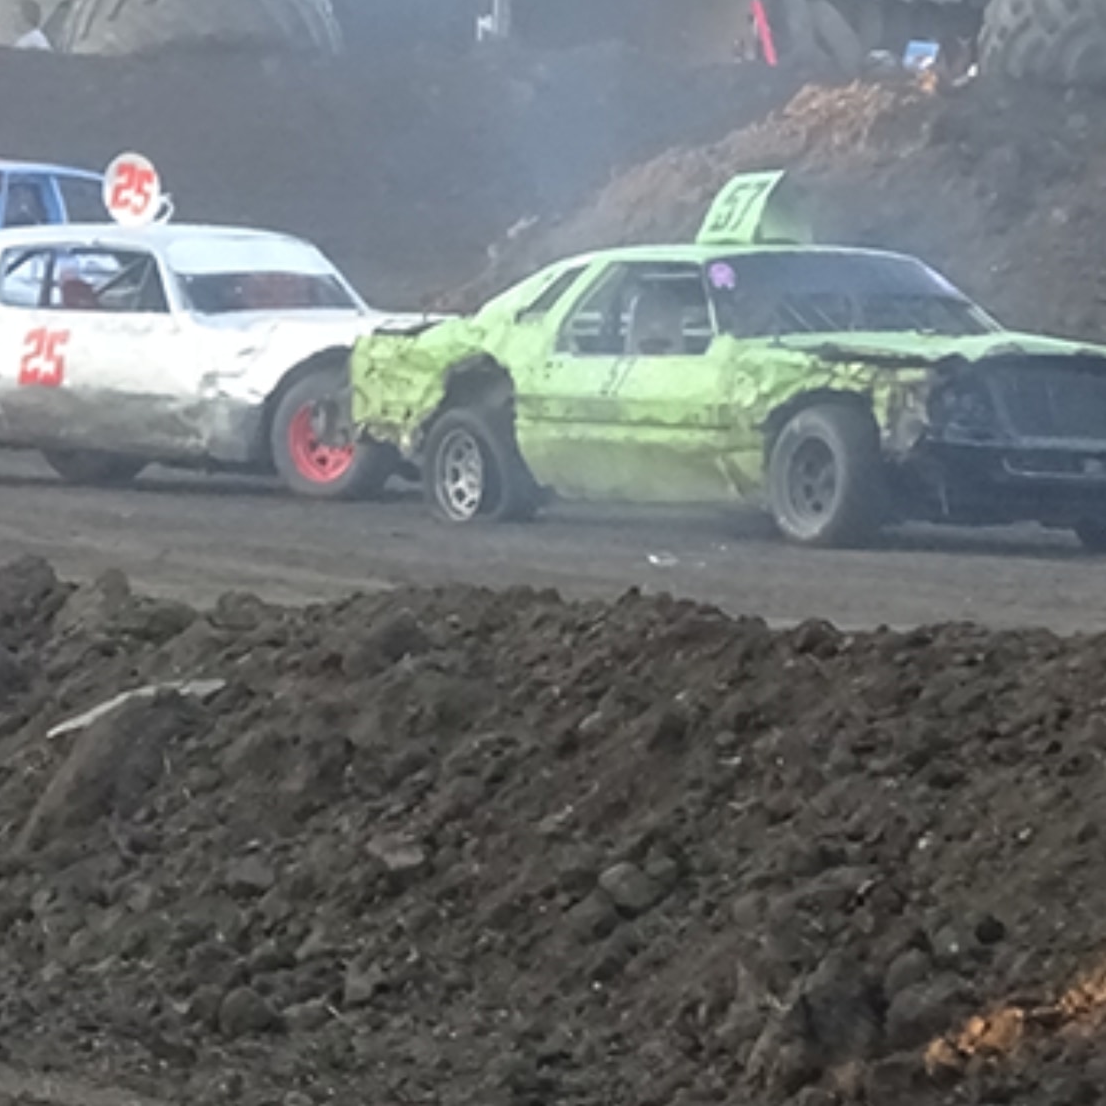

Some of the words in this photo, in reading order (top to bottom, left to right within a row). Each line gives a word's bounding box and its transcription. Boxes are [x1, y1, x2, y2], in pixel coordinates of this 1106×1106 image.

[111, 162, 154, 215] 25
[708, 180, 771, 233] 57
[18, 326, 71, 387] 25
